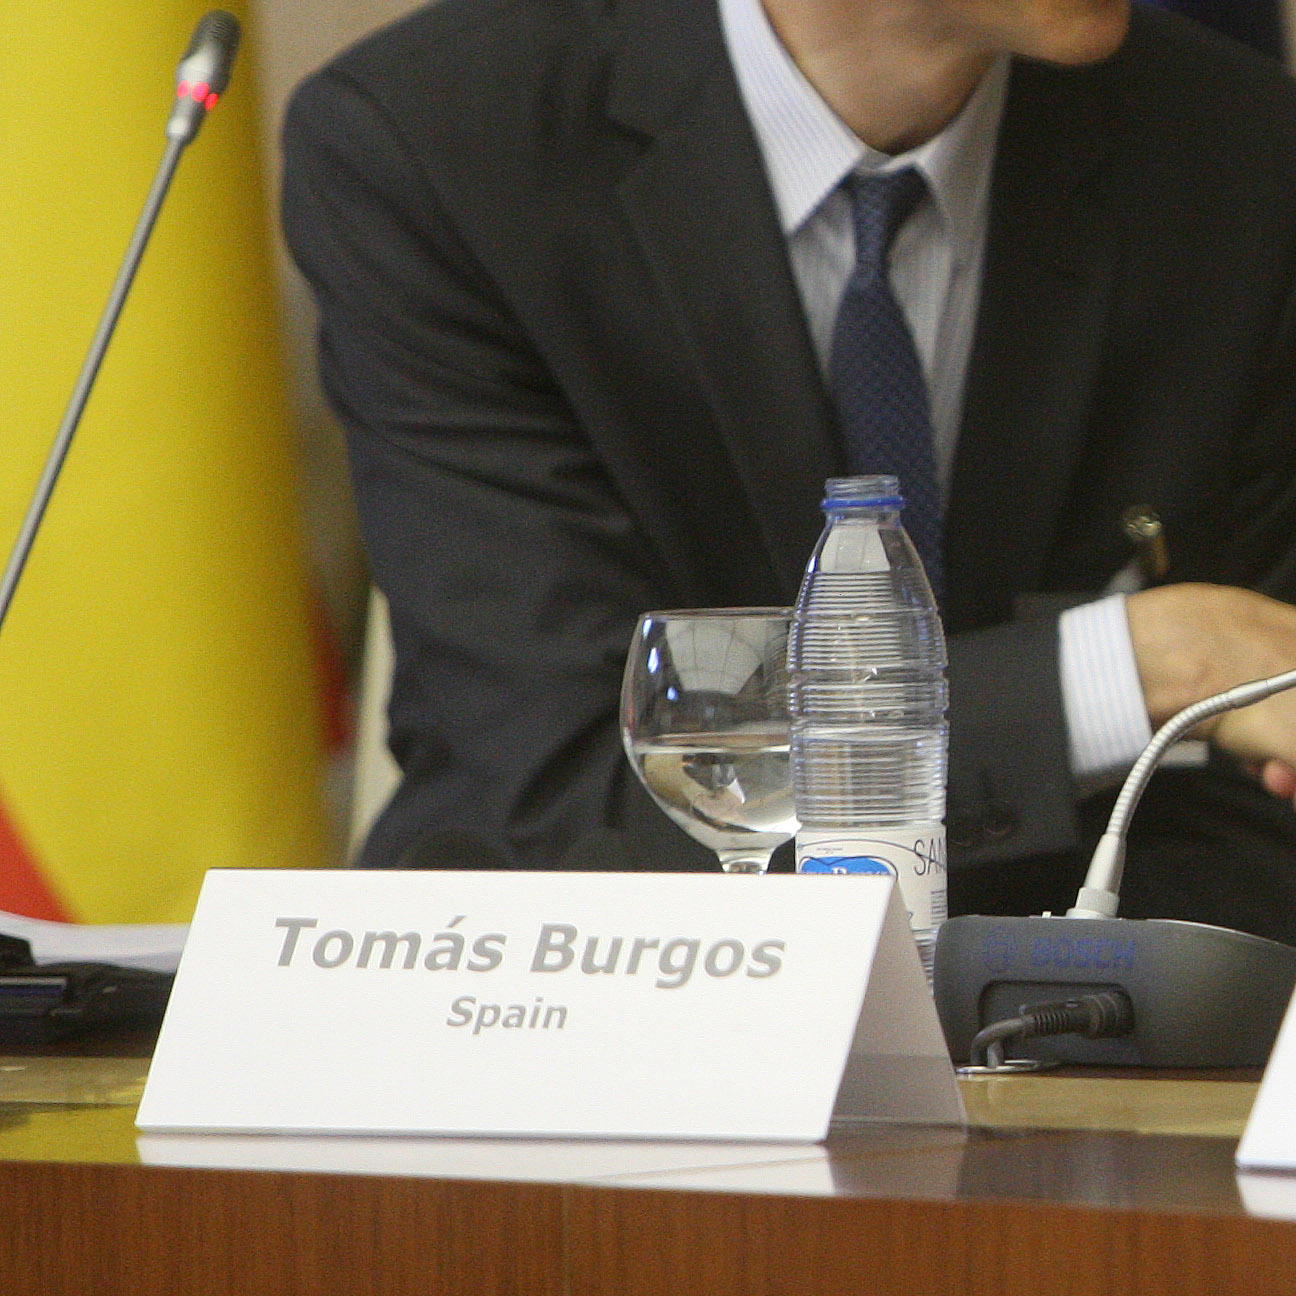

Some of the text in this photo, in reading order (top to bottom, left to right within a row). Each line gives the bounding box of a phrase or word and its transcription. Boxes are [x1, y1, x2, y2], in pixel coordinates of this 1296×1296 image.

[274, 915, 786, 990] Tomás Burgos
[1031, 938, 1136, 969] BOSCH
[447, 995, 568, 1035] Spain
